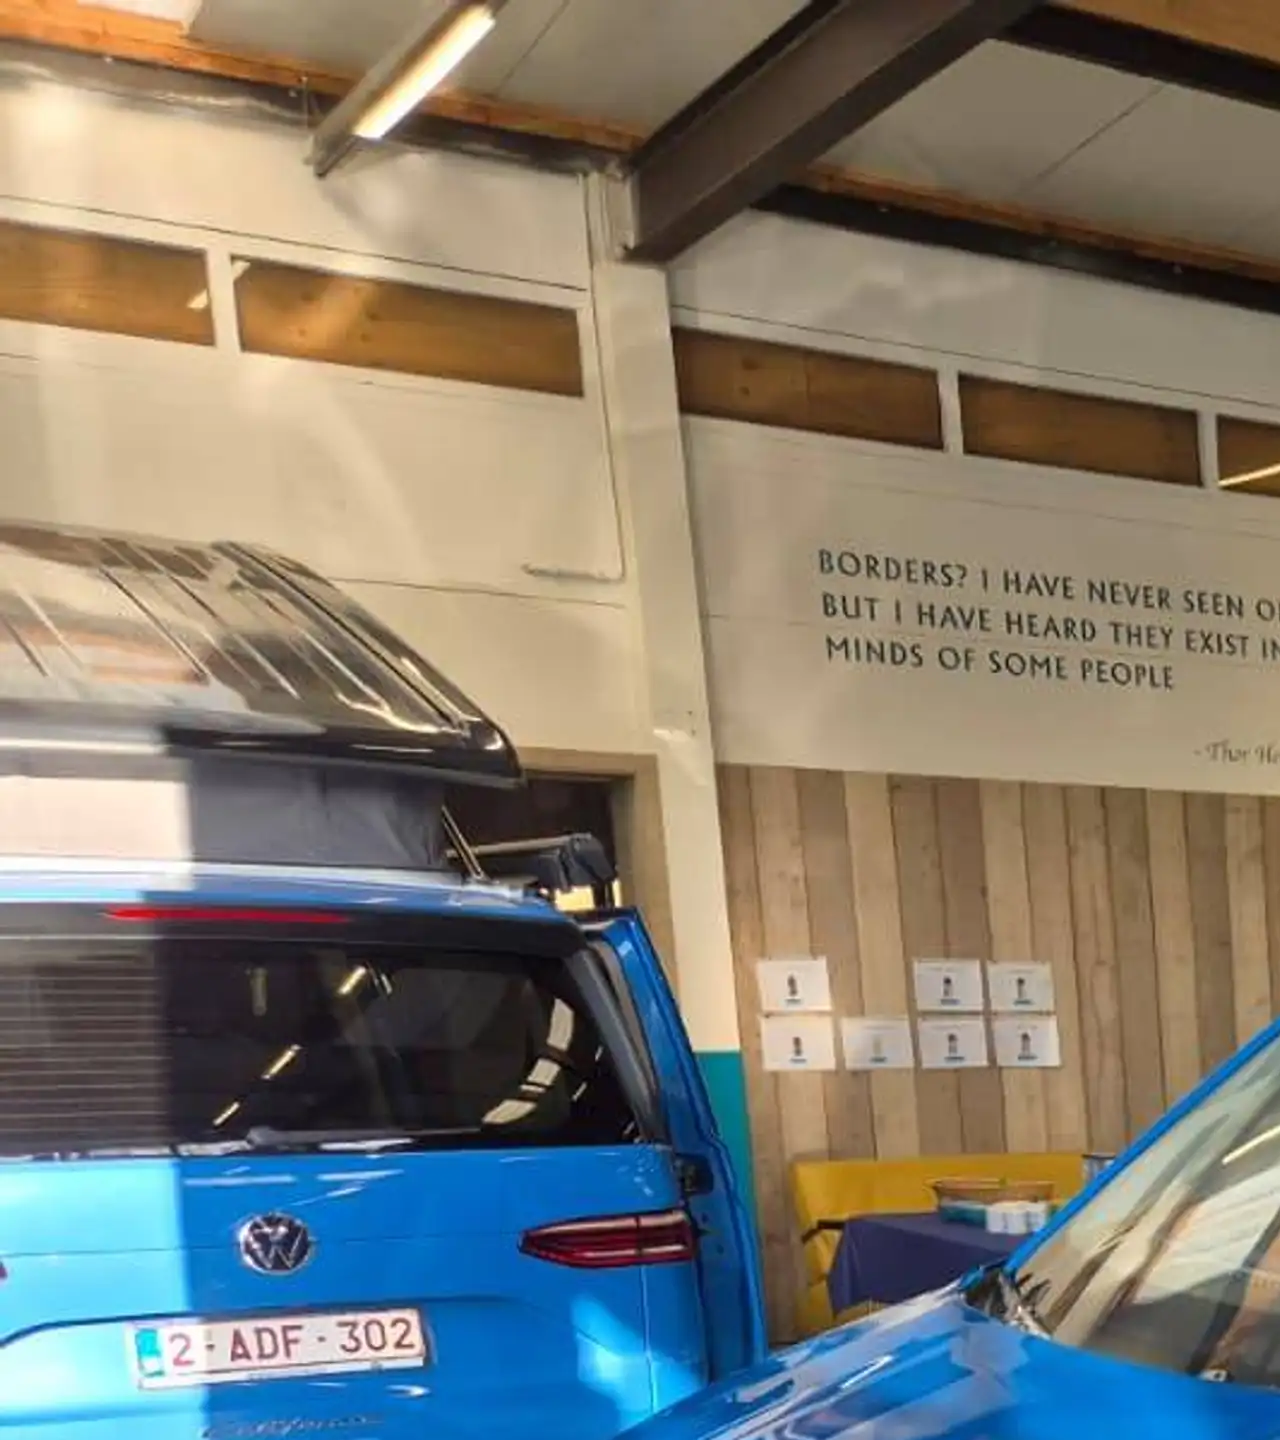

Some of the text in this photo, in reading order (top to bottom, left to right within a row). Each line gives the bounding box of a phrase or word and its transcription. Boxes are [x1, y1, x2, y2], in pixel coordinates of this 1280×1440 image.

[819, 549, 967, 588] BORDERS?
[981, 568, 988, 592] I
[1003, 570, 1075, 600] HAVE
[1087, 579, 1171, 611] NEVER
[1183, 589, 1244, 619] SEEN
[822, 593, 880, 622] BUT
[895, 600, 902, 624] I
[917, 603, 992, 632] HAVE
[1005, 611, 1096, 643] HEARD
[1109, 620, 1173, 650] THEY
[1185, 629, 1249, 658] EXIST
[826, 635, 1174, 690] MINDS OF SOME PEOPLE
[1205, 739, 1250, 763] Thor
